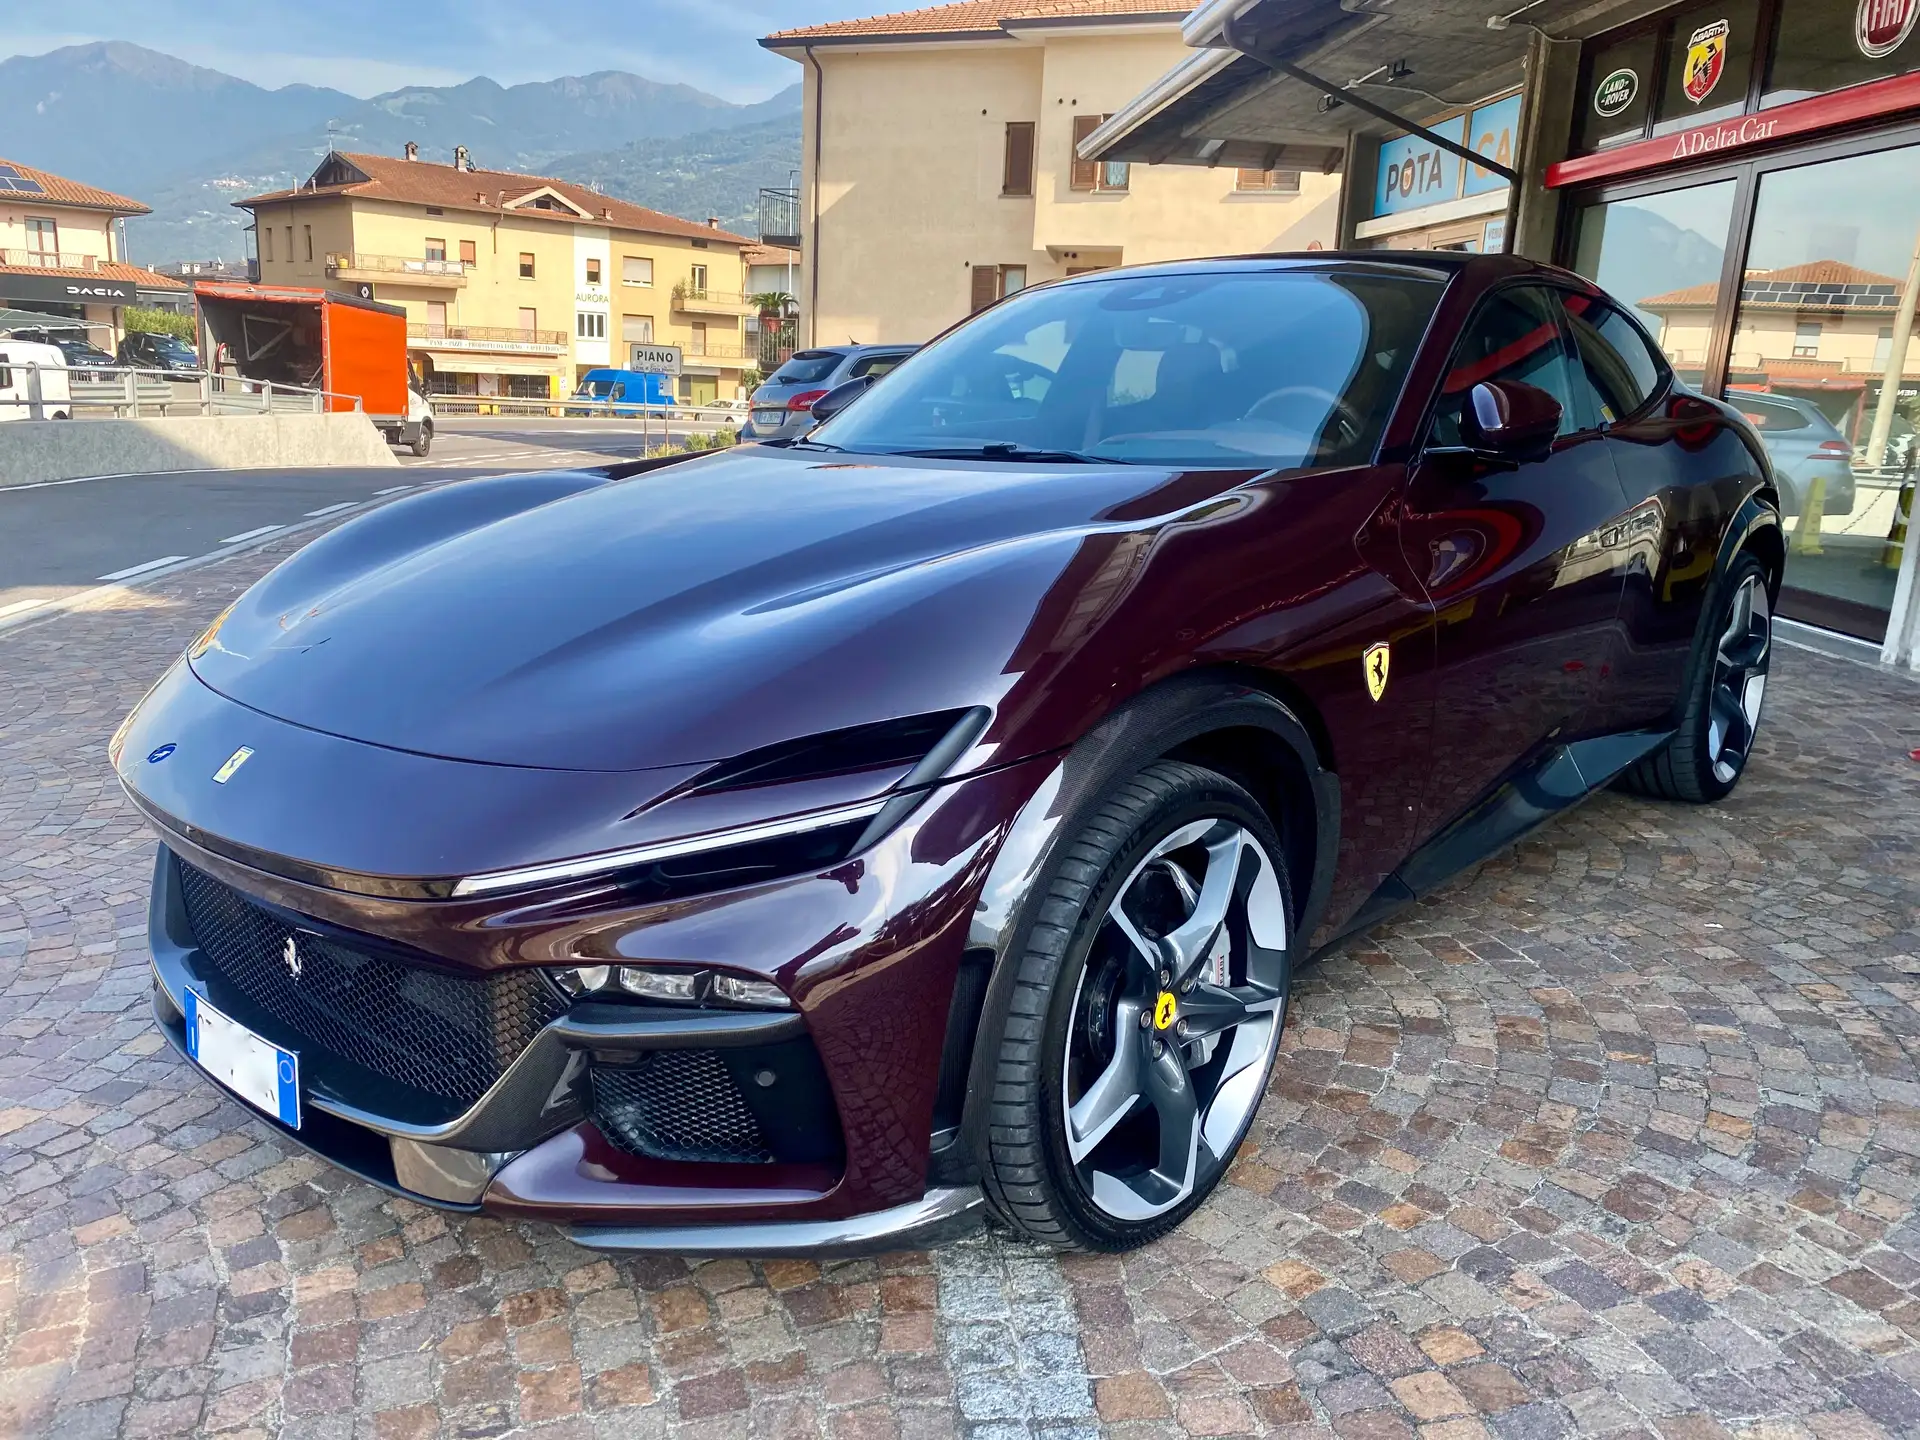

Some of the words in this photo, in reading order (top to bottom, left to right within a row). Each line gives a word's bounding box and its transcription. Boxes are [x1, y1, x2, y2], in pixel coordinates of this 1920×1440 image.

[1693, 25, 1725, 43] ABARTH
[1604, 78, 1625, 95] LAND
[1604, 88, 1630, 106] ROVER
[1385, 147, 1442, 203] PÒTA
[66, 286, 125, 297] DACIA
[576, 293, 609, 303] AURORA
[636, 350, 674, 363] PIANO
